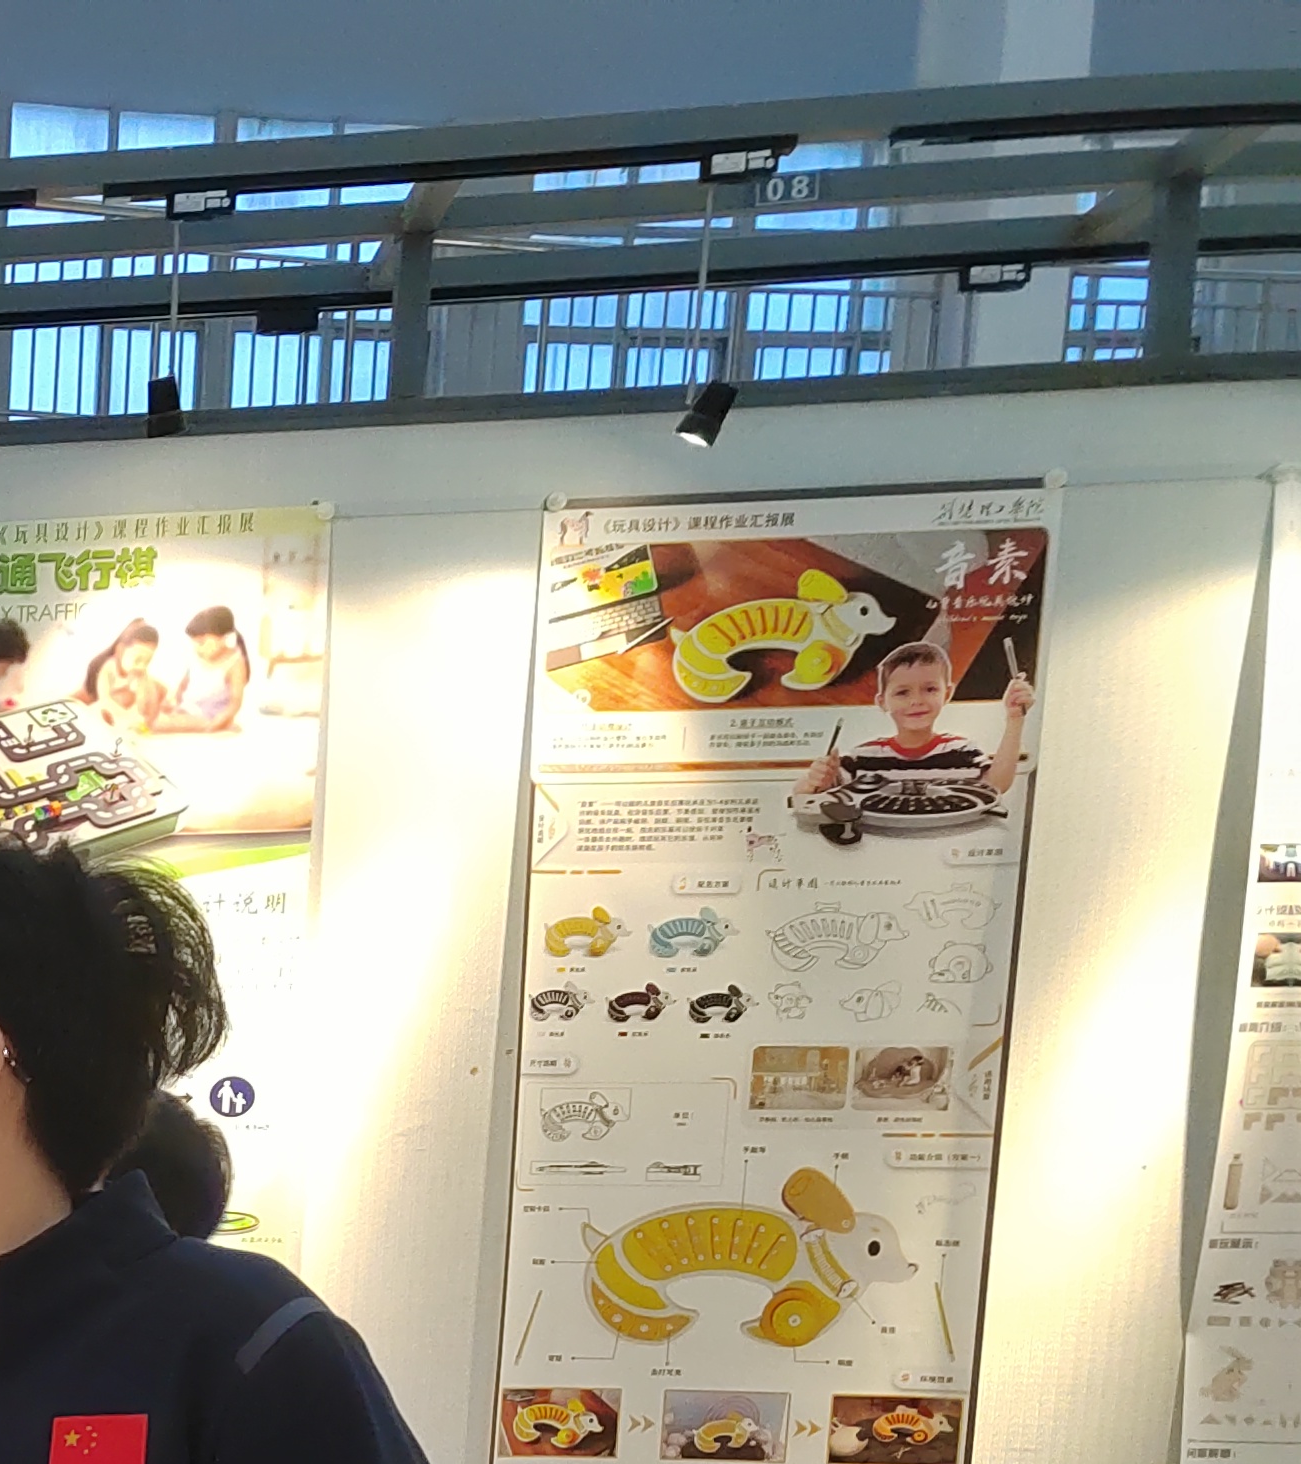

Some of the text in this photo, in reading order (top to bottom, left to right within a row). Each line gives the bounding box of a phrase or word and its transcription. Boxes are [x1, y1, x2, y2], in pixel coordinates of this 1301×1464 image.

[766, 175, 809, 201] 08
[935, 537, 1029, 590] 音素
[201, 891, 287, 916] 计说明
